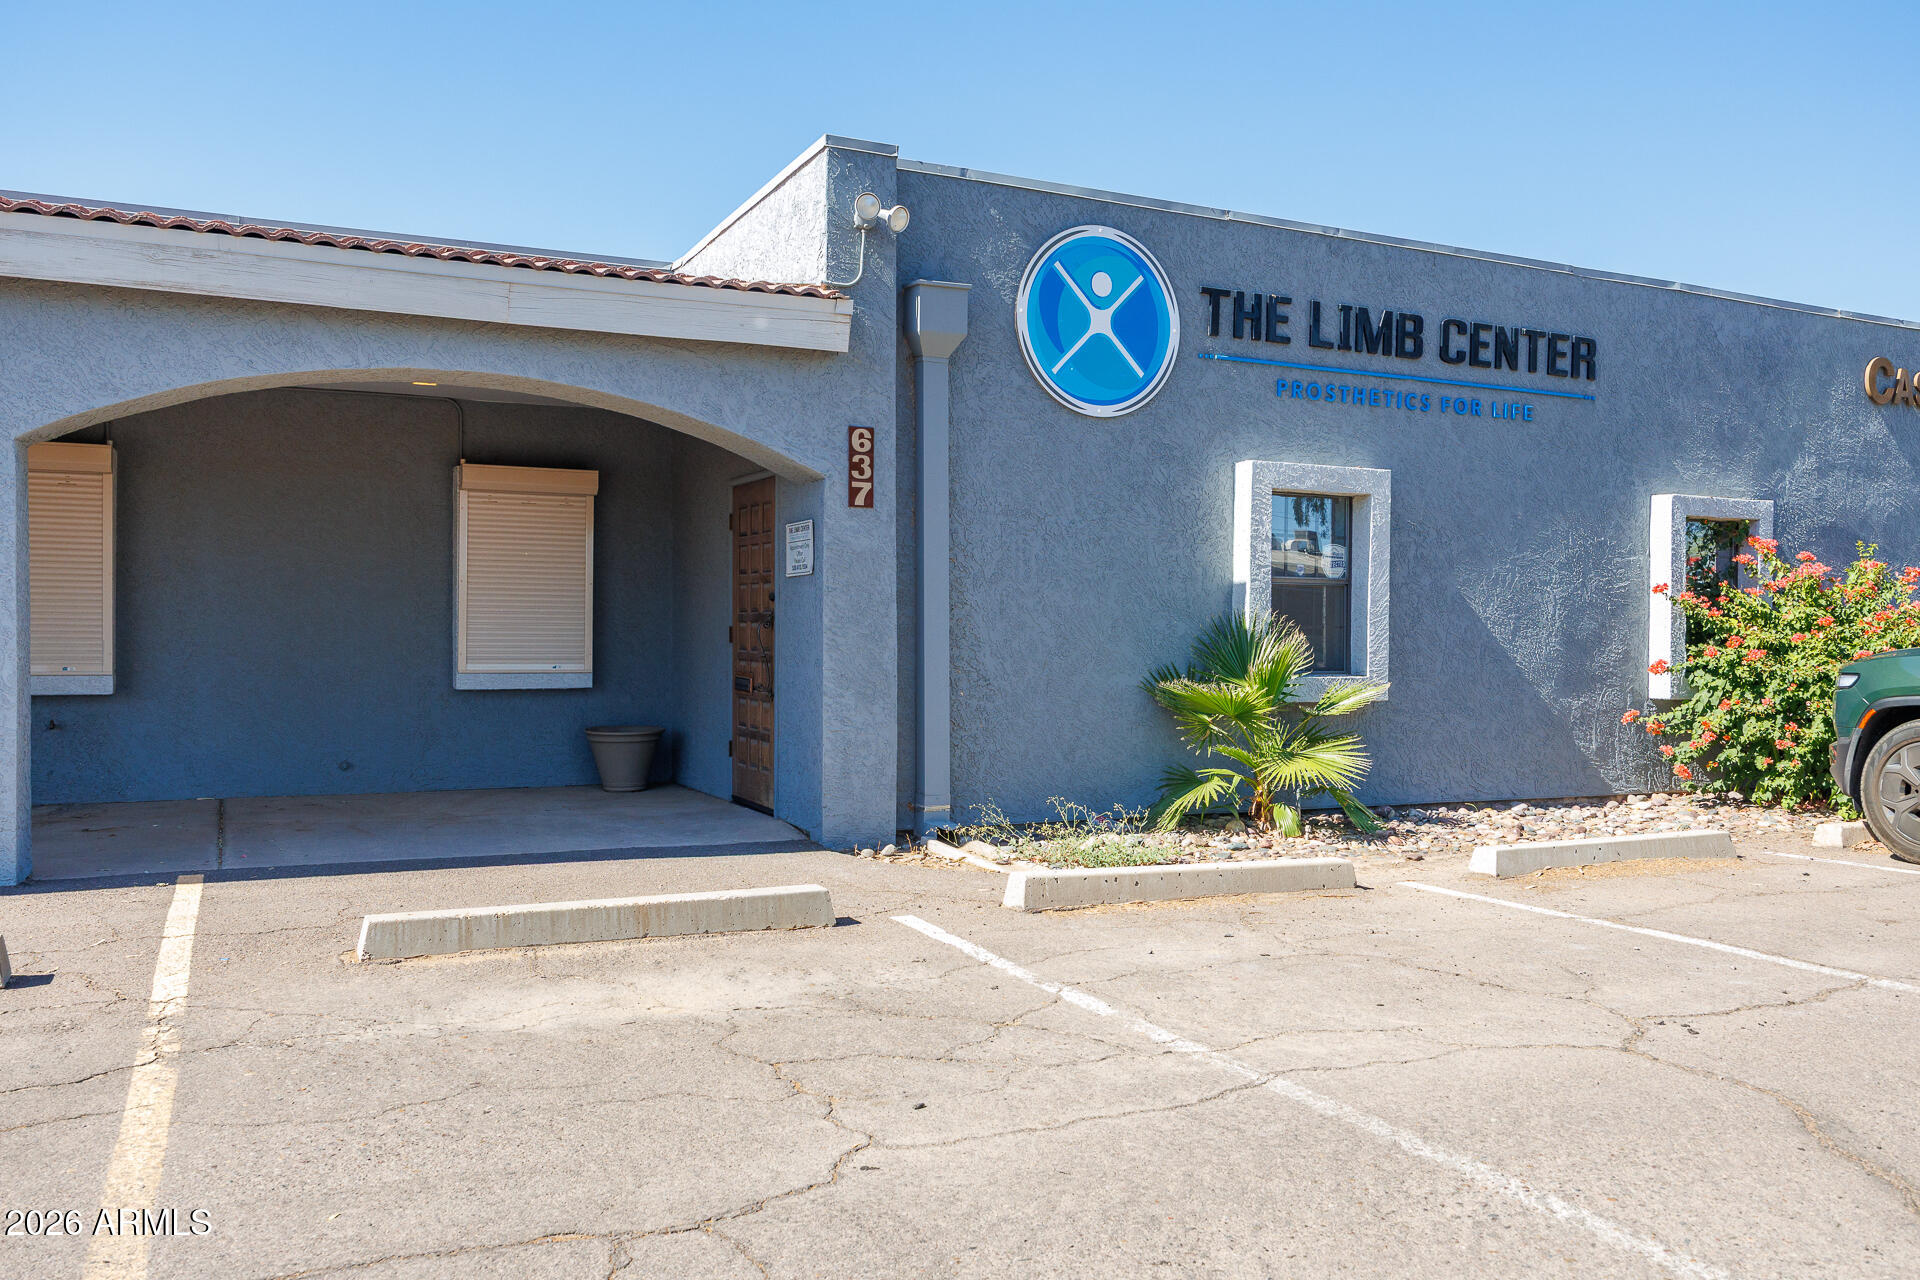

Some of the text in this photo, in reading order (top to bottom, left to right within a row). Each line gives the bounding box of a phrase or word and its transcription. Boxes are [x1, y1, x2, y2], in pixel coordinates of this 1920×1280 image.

[1200, 285, 1597, 381] THE LIMB CENTER
[1276, 378, 1535, 422] PROSTHETICS FOR LIFE
[851, 428, 872, 506] 637
